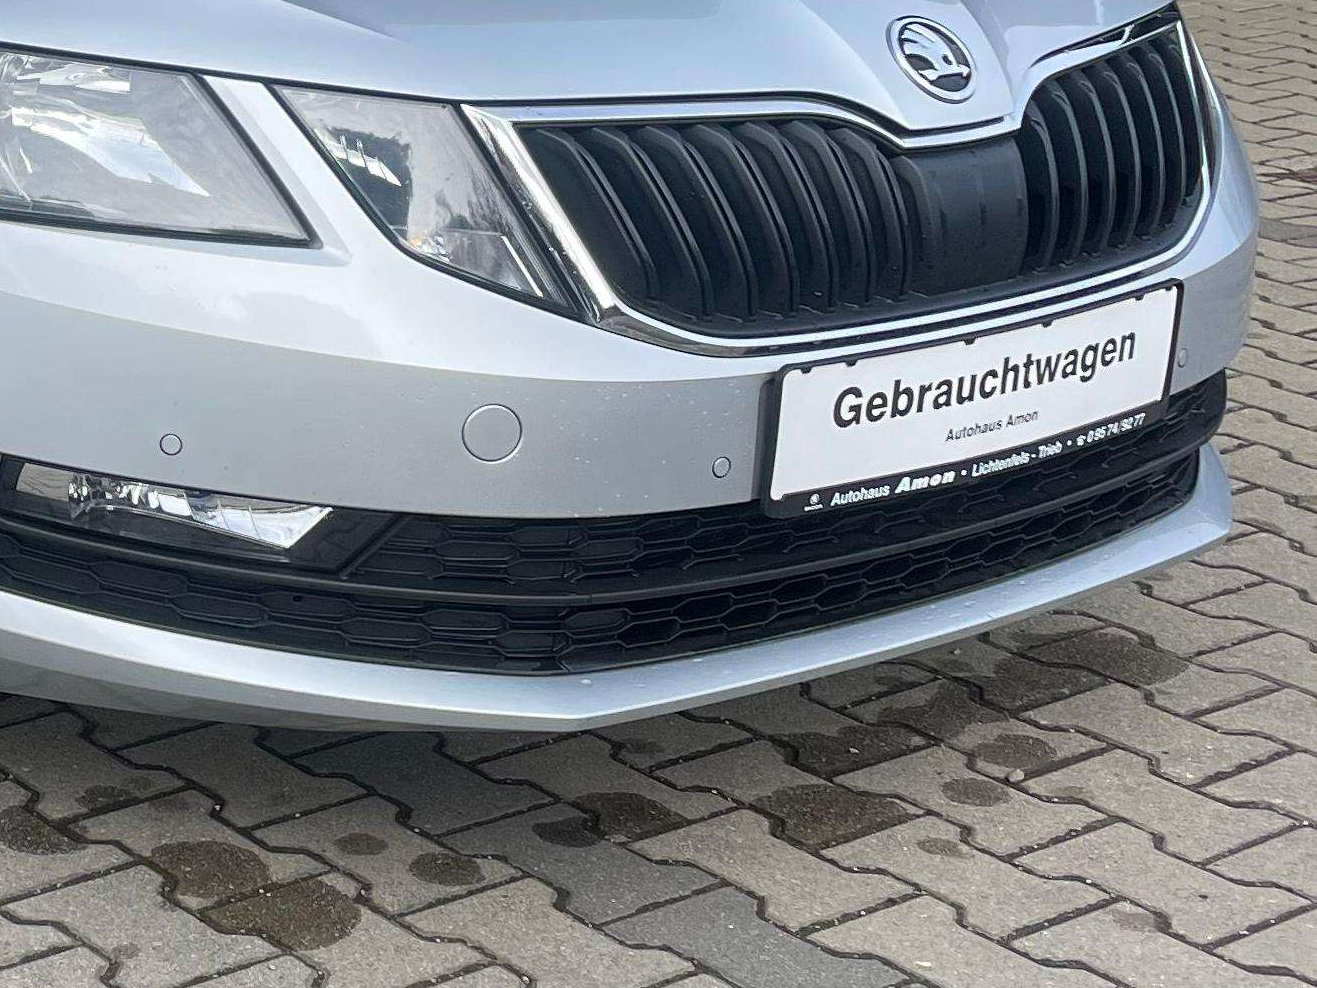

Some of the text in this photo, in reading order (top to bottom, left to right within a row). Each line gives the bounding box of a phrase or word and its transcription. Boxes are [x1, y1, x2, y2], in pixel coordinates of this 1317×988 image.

[833, 332, 1136, 428] Gebrauchtwagen
[946, 410, 1039, 442] Autohaus Amon
[831, 485, 891, 507] Autohaus
[895, 470, 956, 494] Amon
[971, 451, 1031, 478] Lichtenfels
